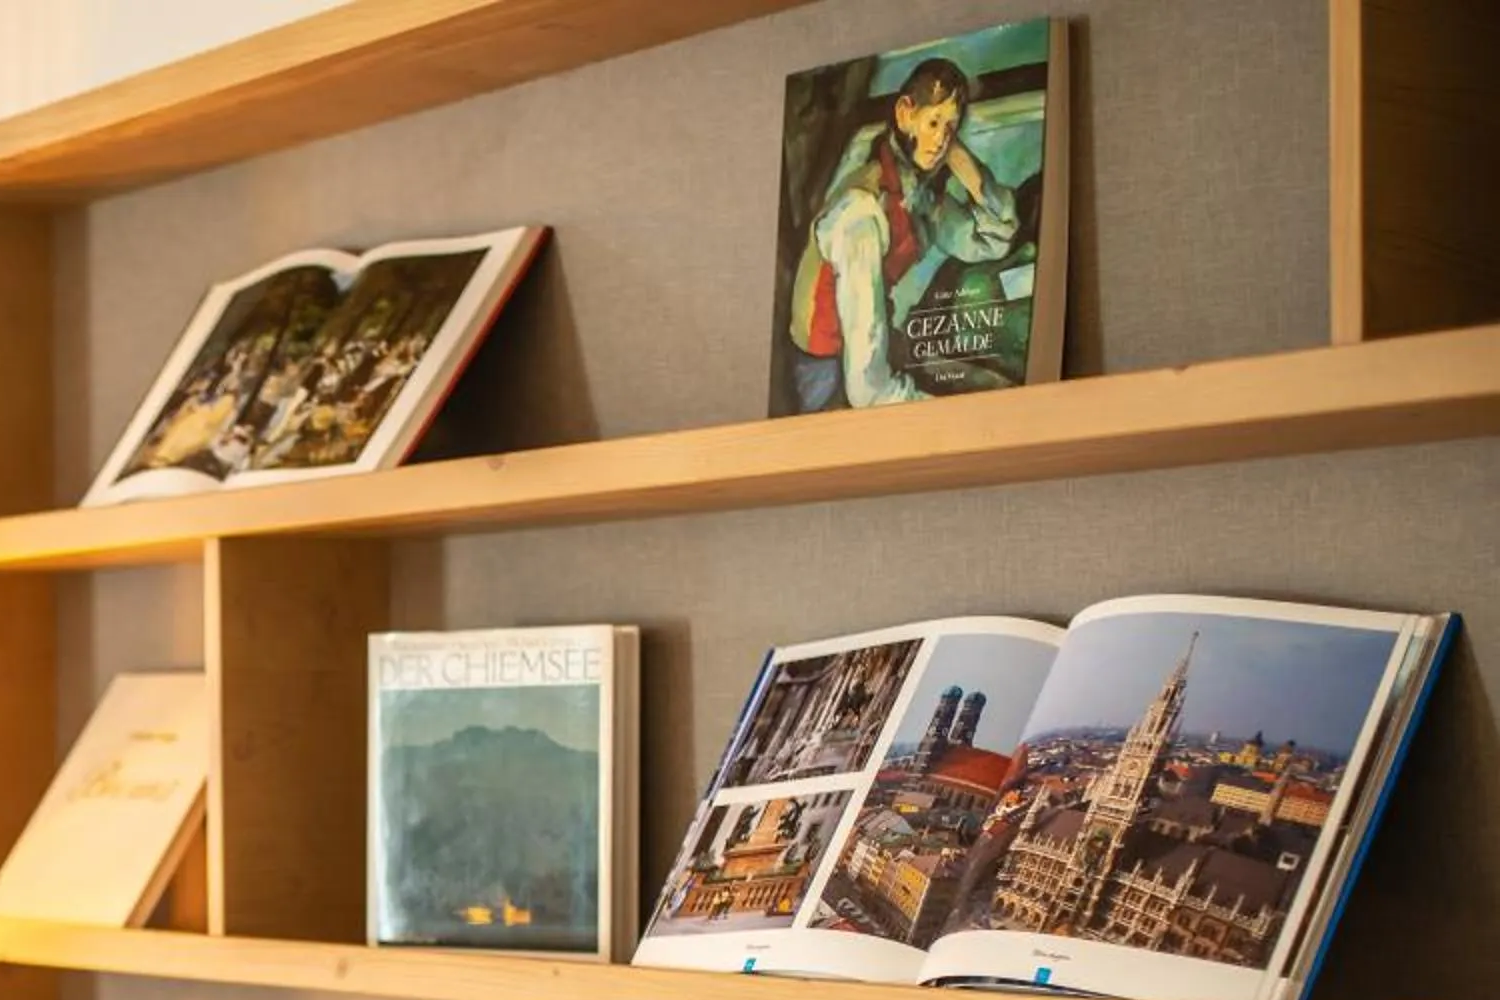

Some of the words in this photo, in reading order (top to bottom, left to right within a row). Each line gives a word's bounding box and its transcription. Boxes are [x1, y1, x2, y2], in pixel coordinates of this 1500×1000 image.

[907, 307, 1003, 339] CEZANNE
[379, 653, 433, 687] DER
[441, 648, 600, 685] CHIEMSEE
